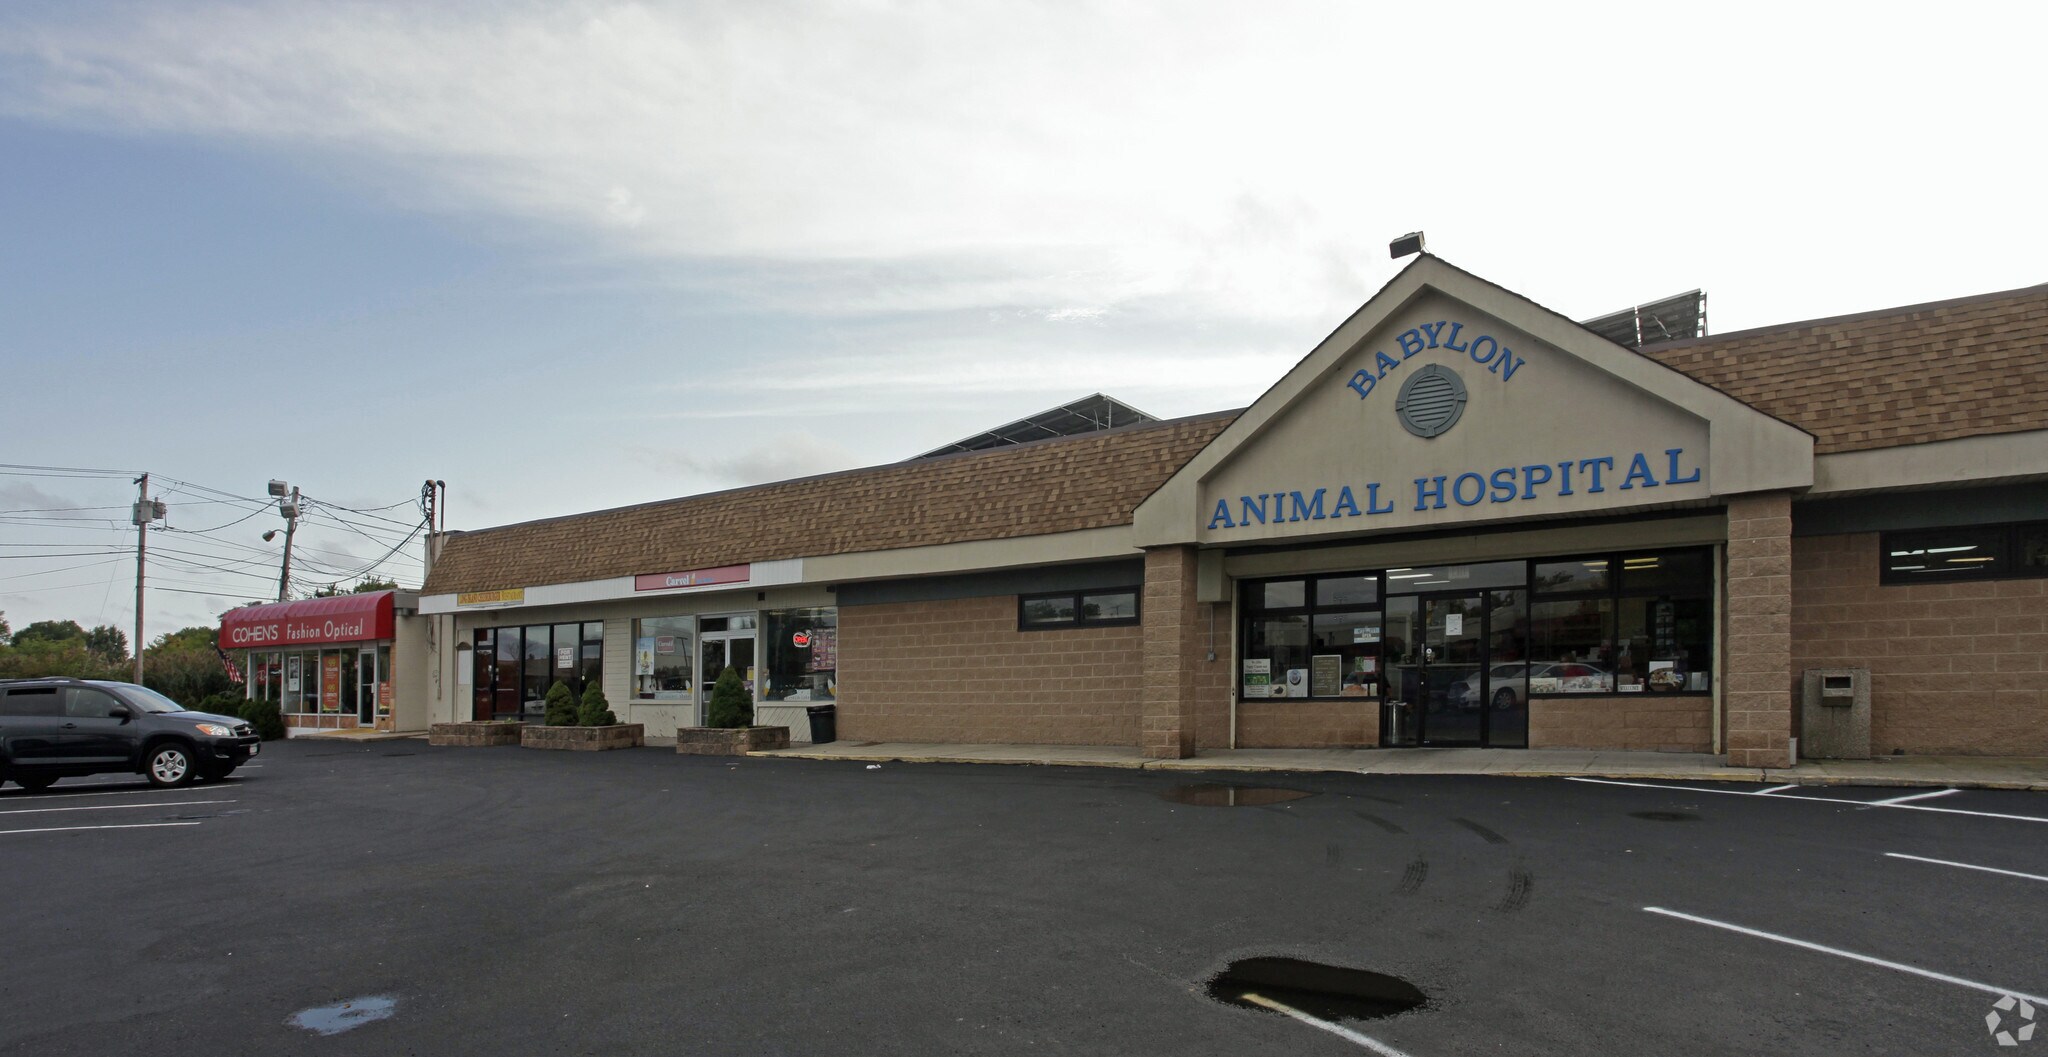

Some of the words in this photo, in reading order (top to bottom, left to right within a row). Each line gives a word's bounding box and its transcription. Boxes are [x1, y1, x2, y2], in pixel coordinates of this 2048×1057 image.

[1346, 320, 1526, 400] BABYLON
[1207, 482, 1394, 529] ANIMAL
[1413, 448, 1700, 511] HOSPITAL
[666, 574, 690, 586] Carvel
[232, 624, 279, 643] COHEN'S
[286, 622, 320, 640] Fashion
[323, 617, 363, 641] Optical
